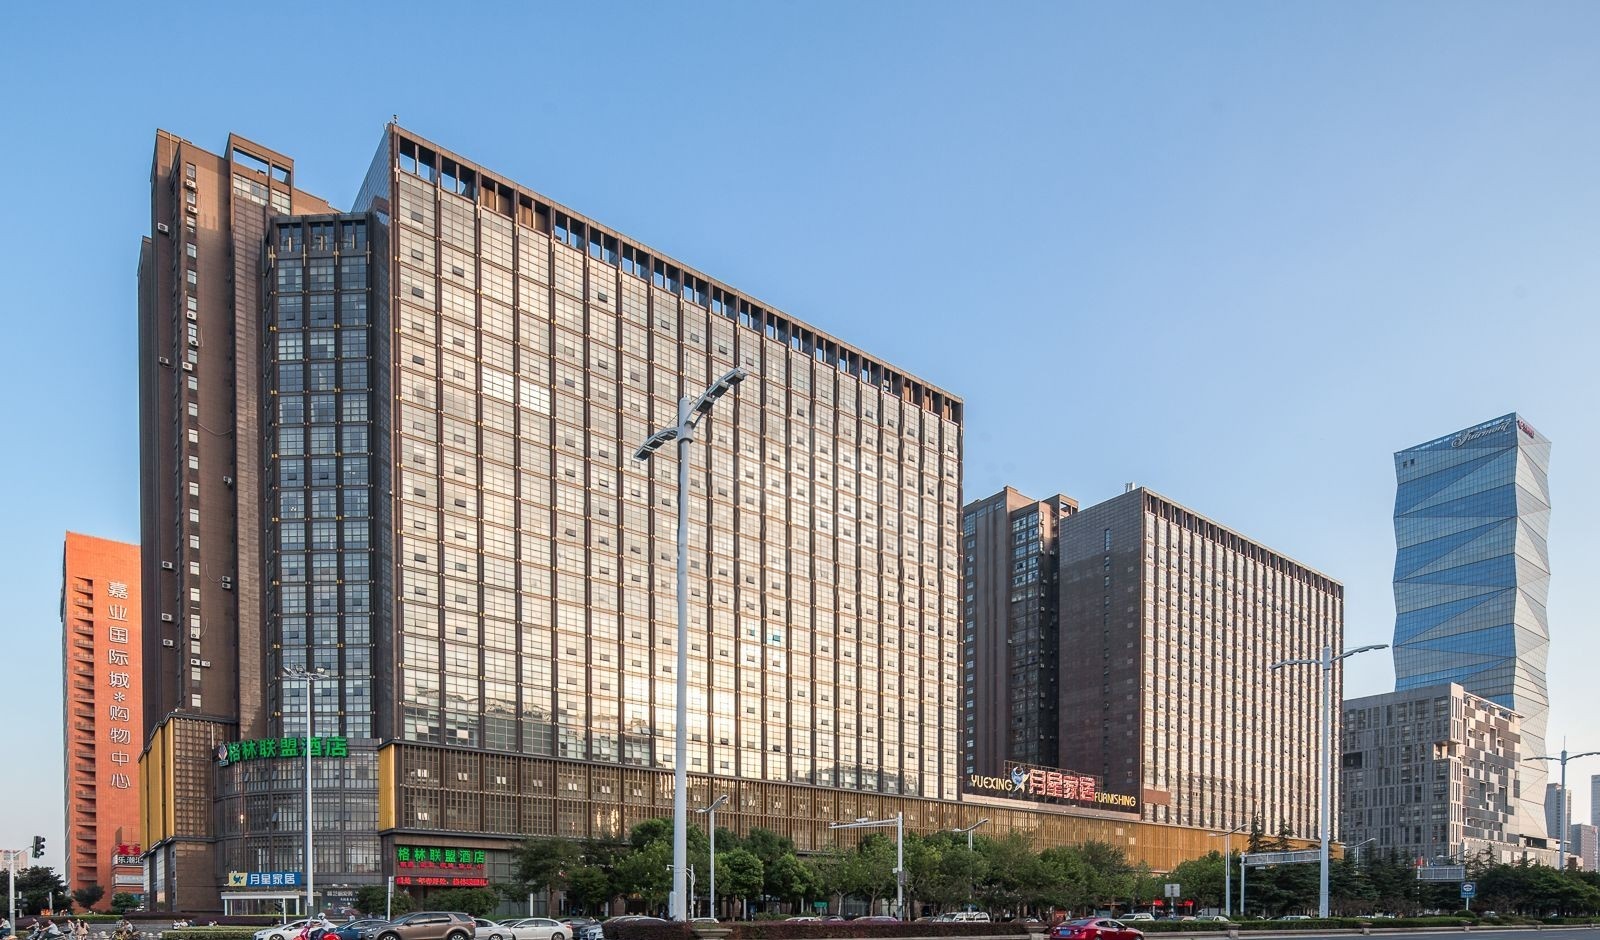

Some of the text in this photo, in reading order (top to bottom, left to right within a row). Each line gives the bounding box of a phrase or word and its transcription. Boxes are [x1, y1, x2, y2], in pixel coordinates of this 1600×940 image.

[228, 736, 348, 762] 格林联盟酒店
[971, 768, 1137, 807] YUEXING 月星家居 FURNISHING
[398, 847, 485, 864] 格林联盟酒店
[250, 873, 296, 885] 月星家居
